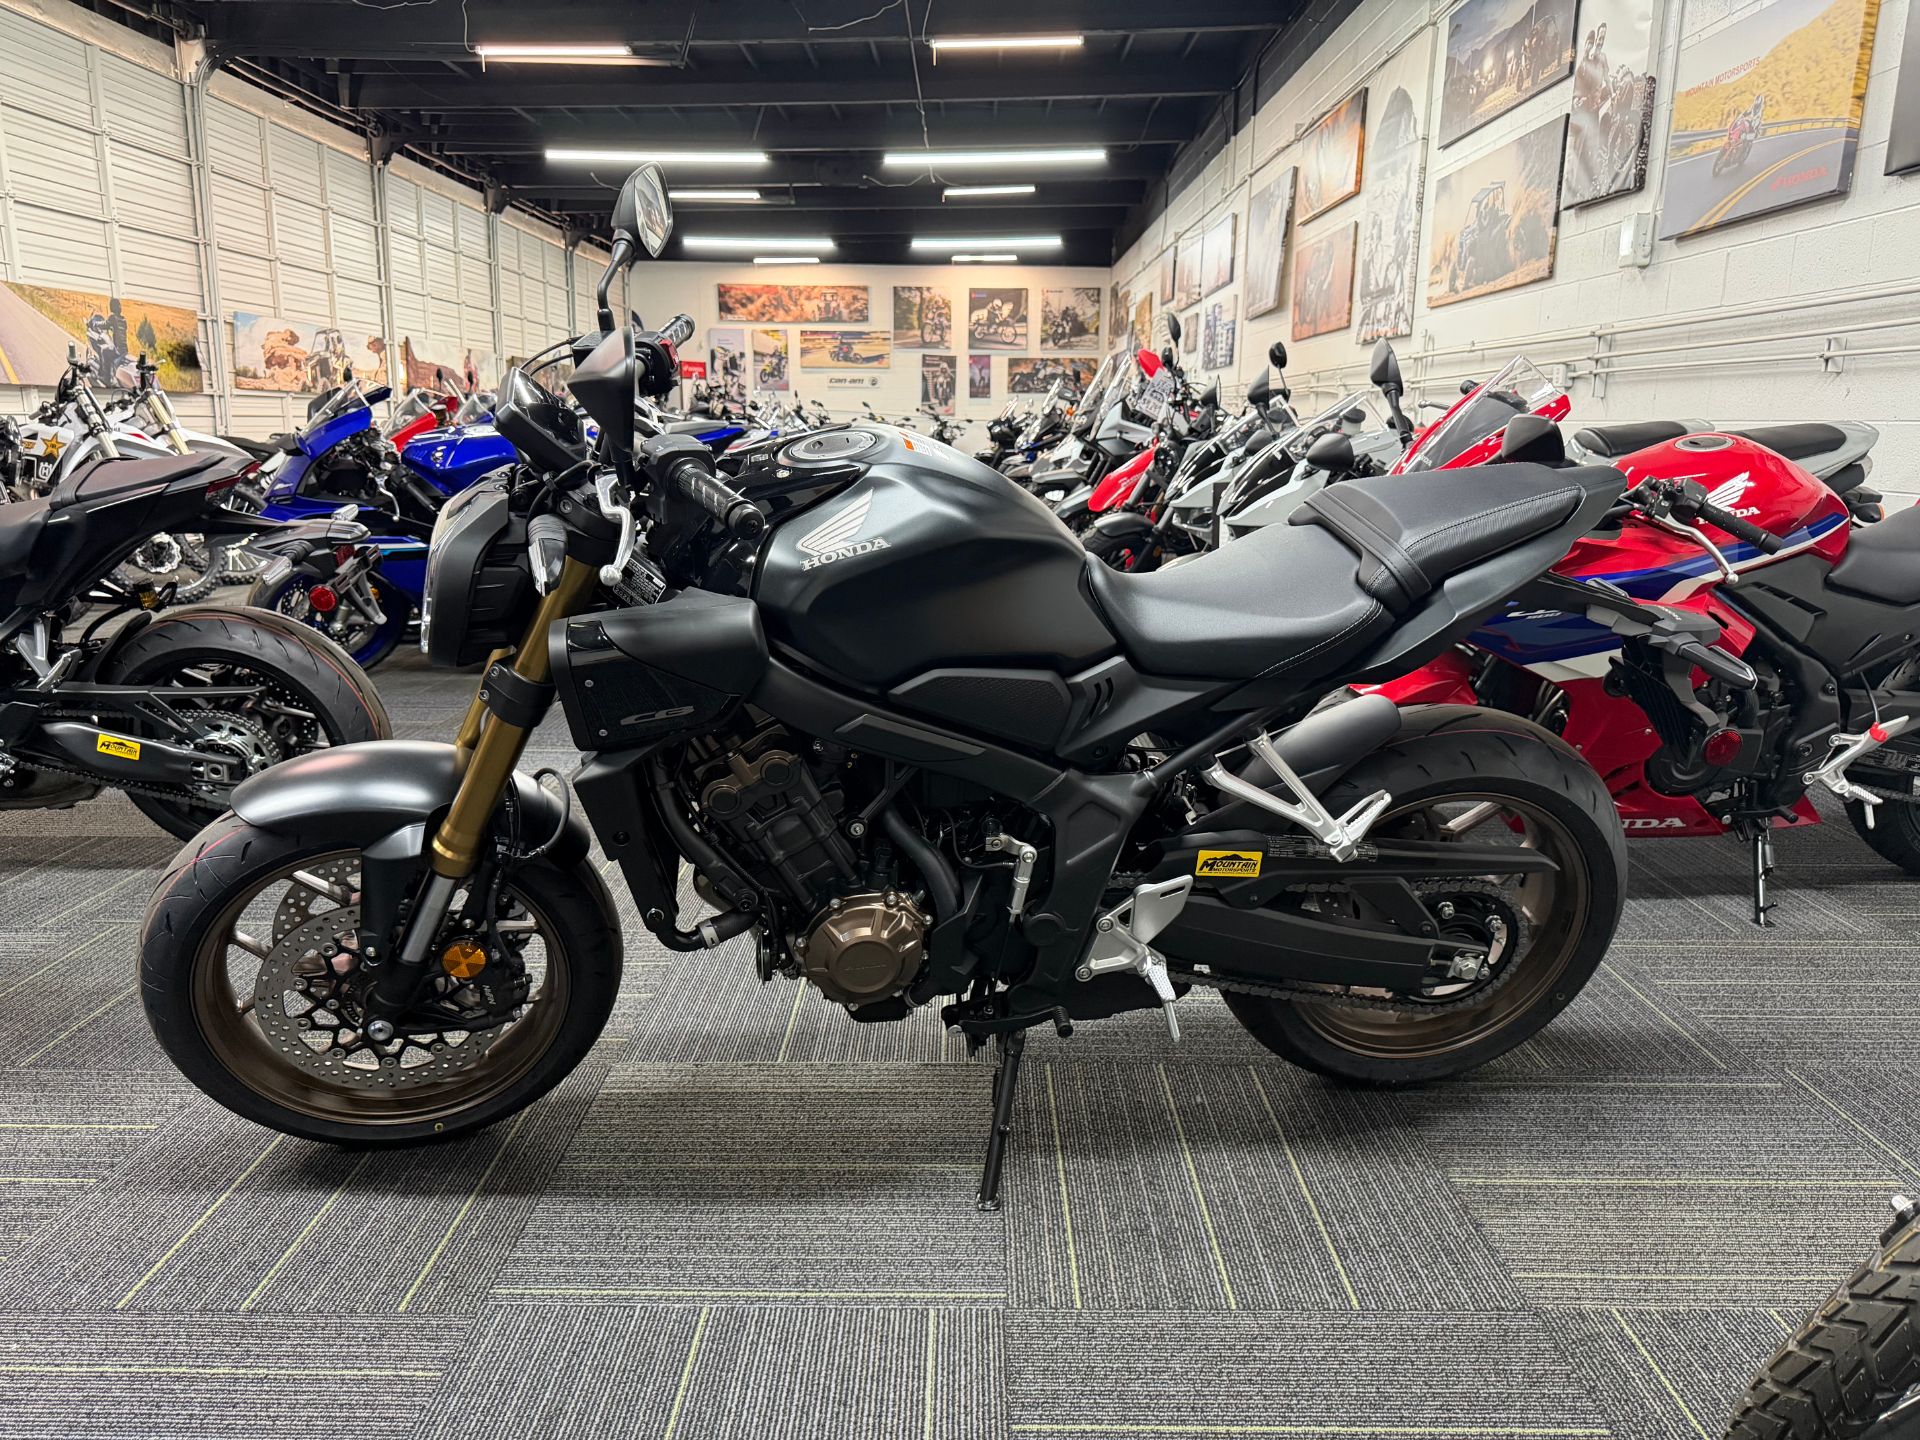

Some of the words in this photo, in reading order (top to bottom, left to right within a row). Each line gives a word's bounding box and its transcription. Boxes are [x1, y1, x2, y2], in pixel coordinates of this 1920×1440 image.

[1714, 56, 1760, 82] MOTORSPORTS
[800, 536, 892, 571] HONDA
[1199, 860, 1258, 872] MOUNTAIN
